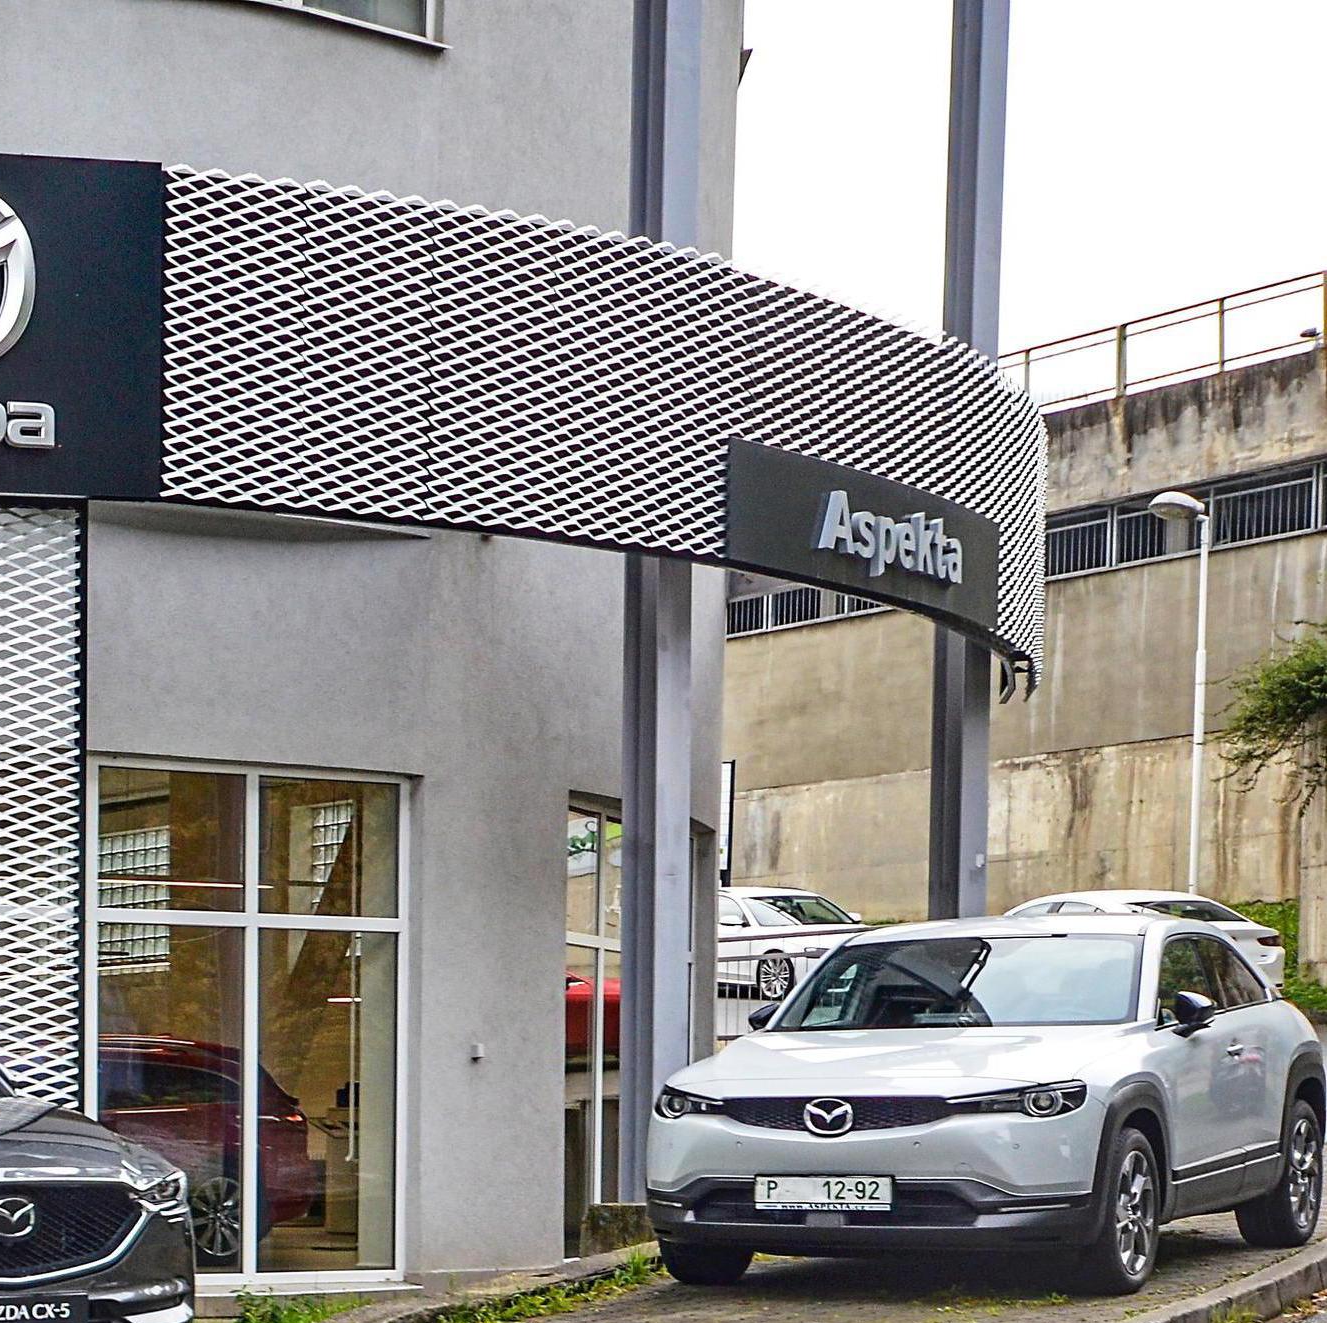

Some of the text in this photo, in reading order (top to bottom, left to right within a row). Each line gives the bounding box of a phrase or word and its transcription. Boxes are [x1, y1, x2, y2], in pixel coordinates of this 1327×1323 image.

[817, 489, 963, 584] Aspekta
[767, 1180, 880, 1200] P 12-92
[31, 1303, 71, 1320] CX-5
